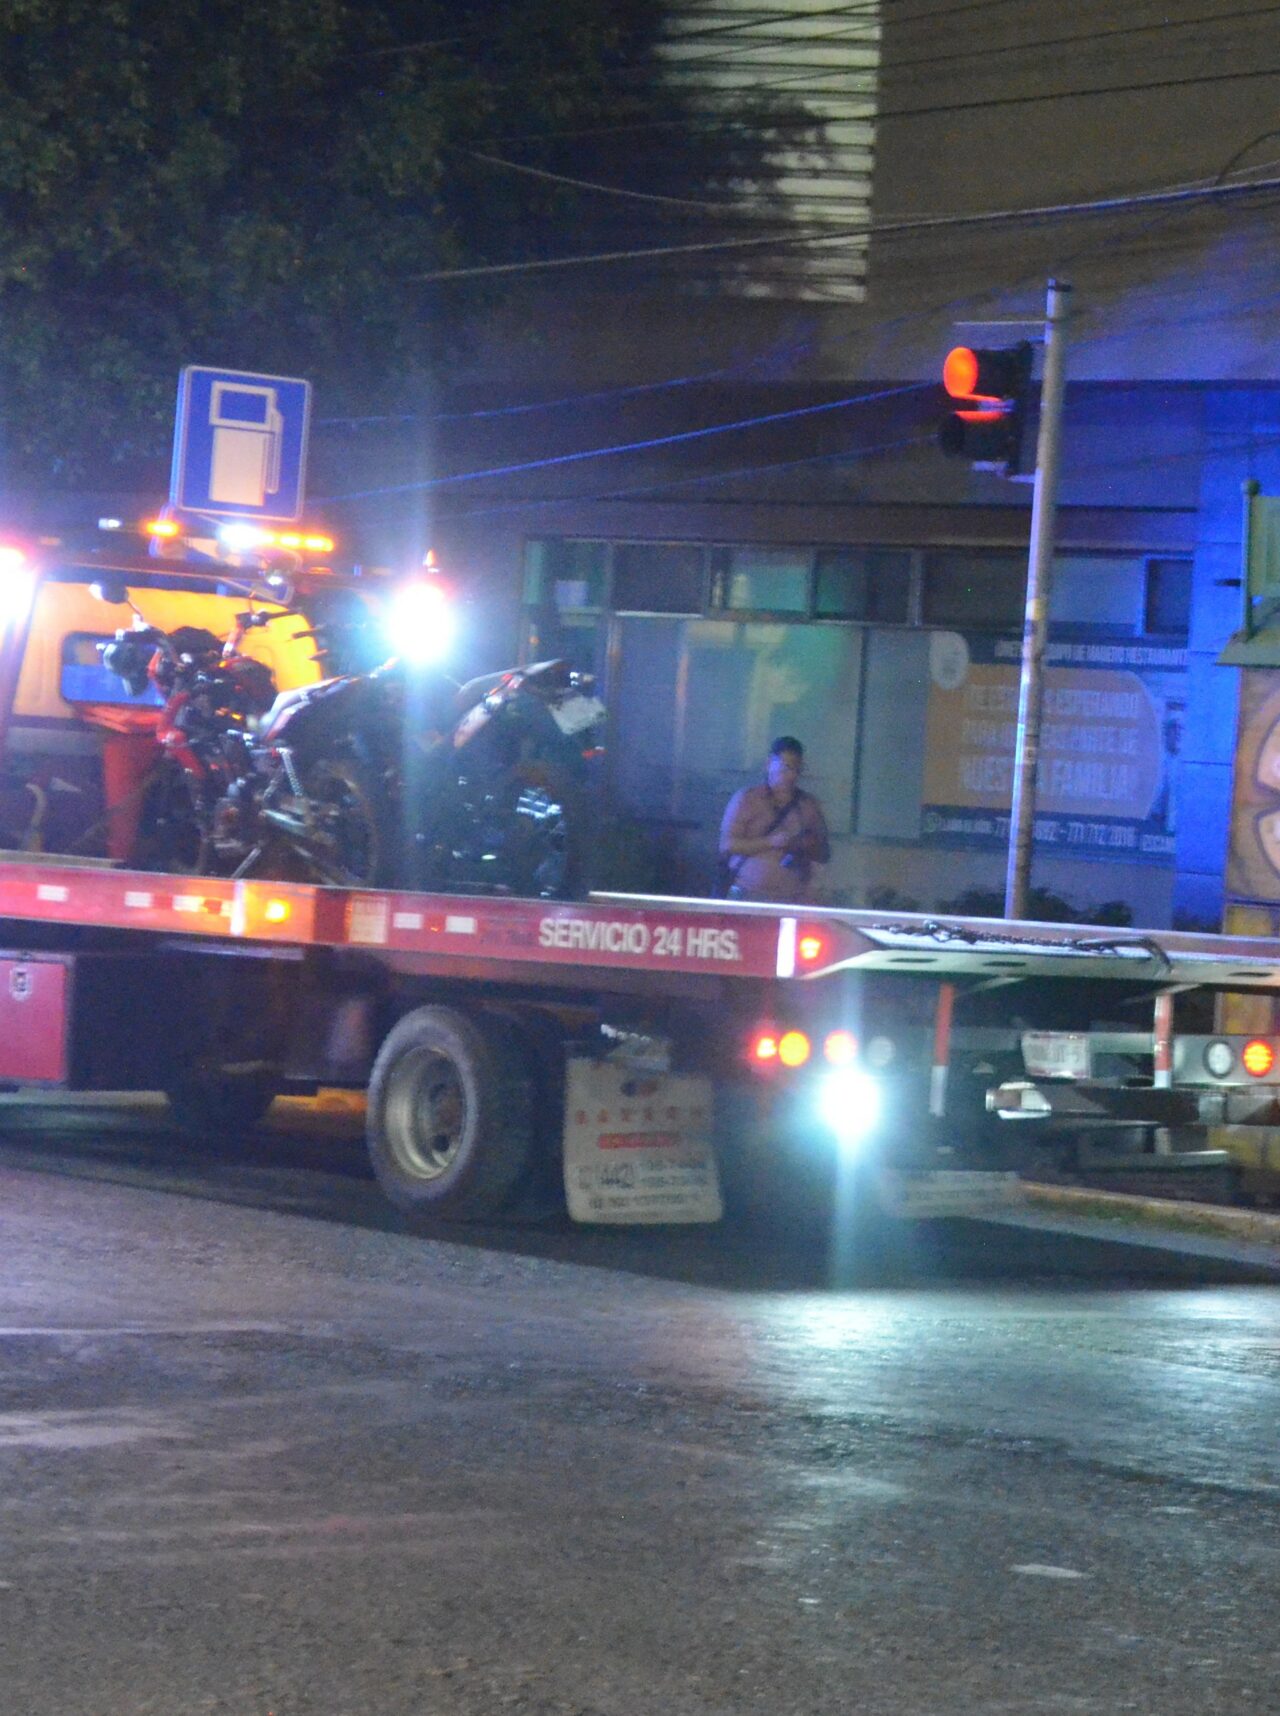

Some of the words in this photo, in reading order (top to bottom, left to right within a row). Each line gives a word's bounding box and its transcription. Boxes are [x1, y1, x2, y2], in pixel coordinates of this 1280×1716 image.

[539, 918, 648, 954] SERVICIO
[652, 926, 681, 957] 24
[687, 928, 742, 960] HRS.
